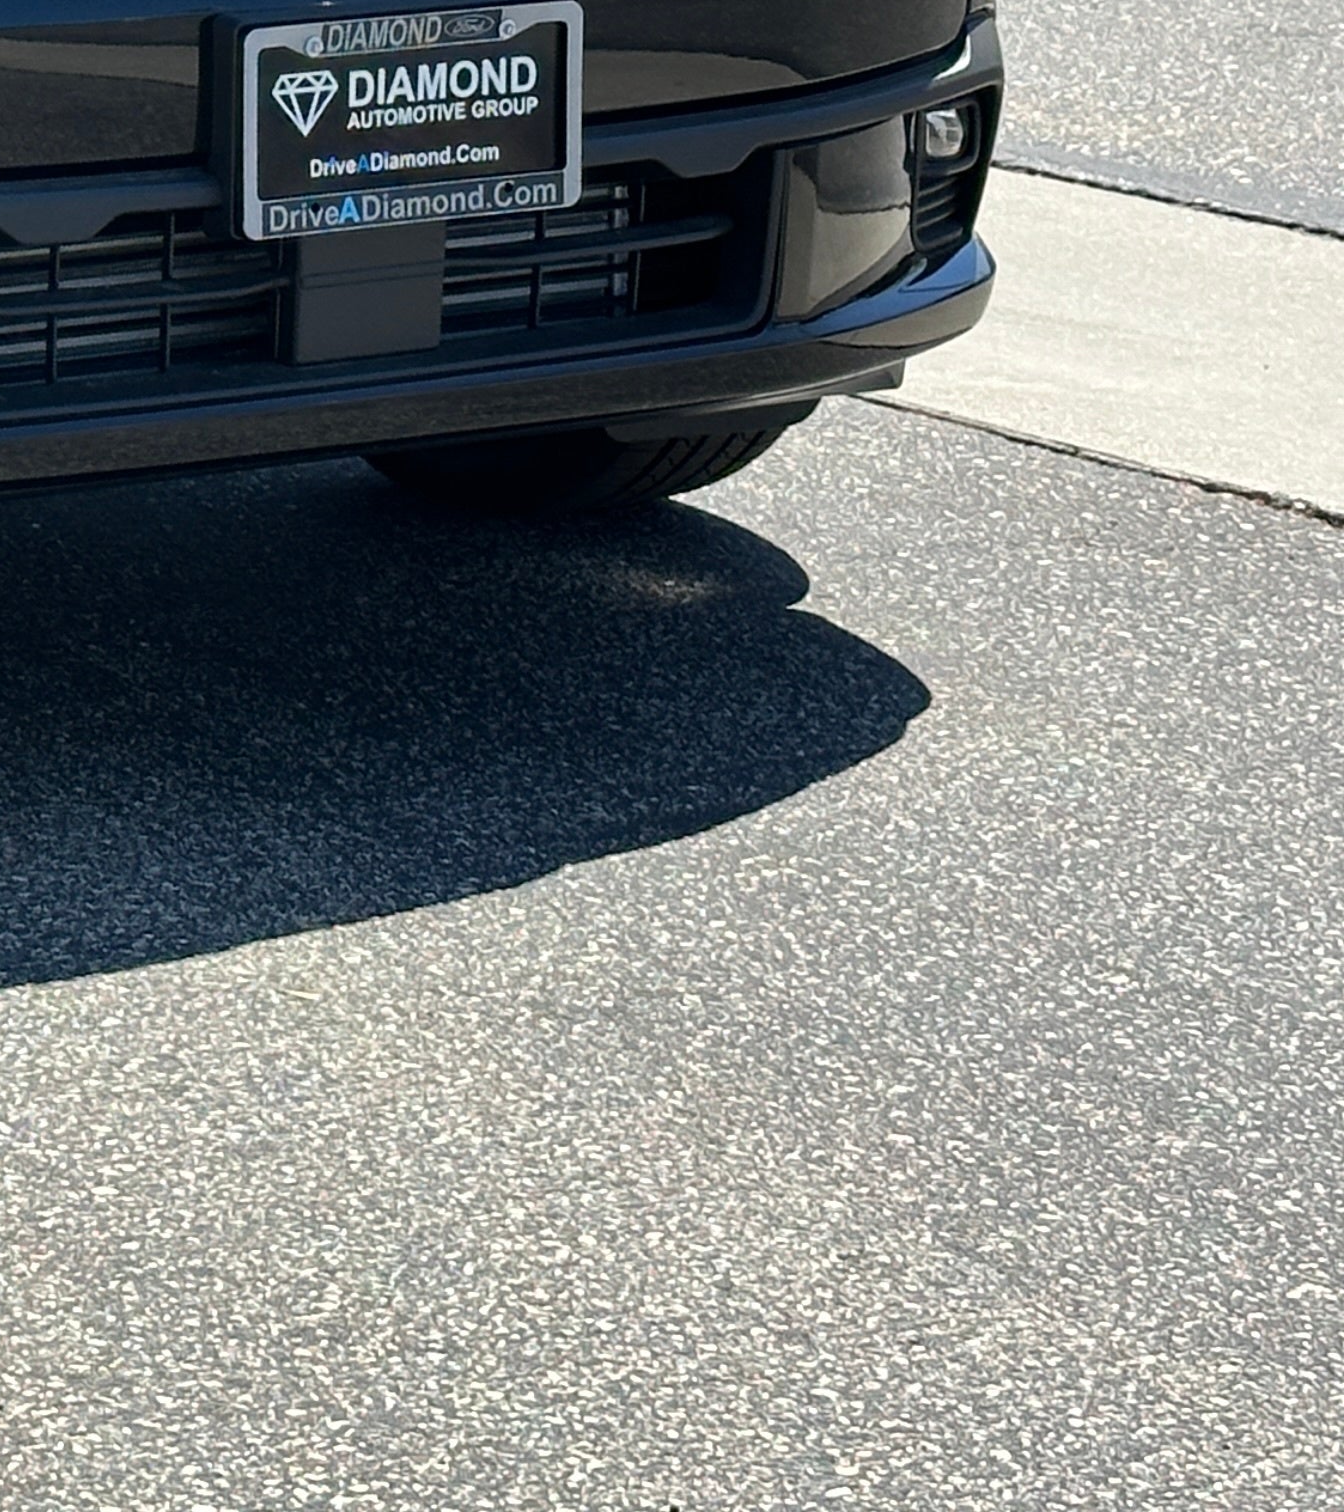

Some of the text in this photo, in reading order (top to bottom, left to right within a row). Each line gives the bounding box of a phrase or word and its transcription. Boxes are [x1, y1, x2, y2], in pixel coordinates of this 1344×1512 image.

[327, 16, 442, 53] DIAMOND
[347, 56, 537, 108] DIAMOND
[346, 96, 539, 131] AUTOMOTIVE GROUP
[310, 144, 499, 178] DriveADiamond.Com
[269, 180, 557, 233] DriveADiamond.Com
